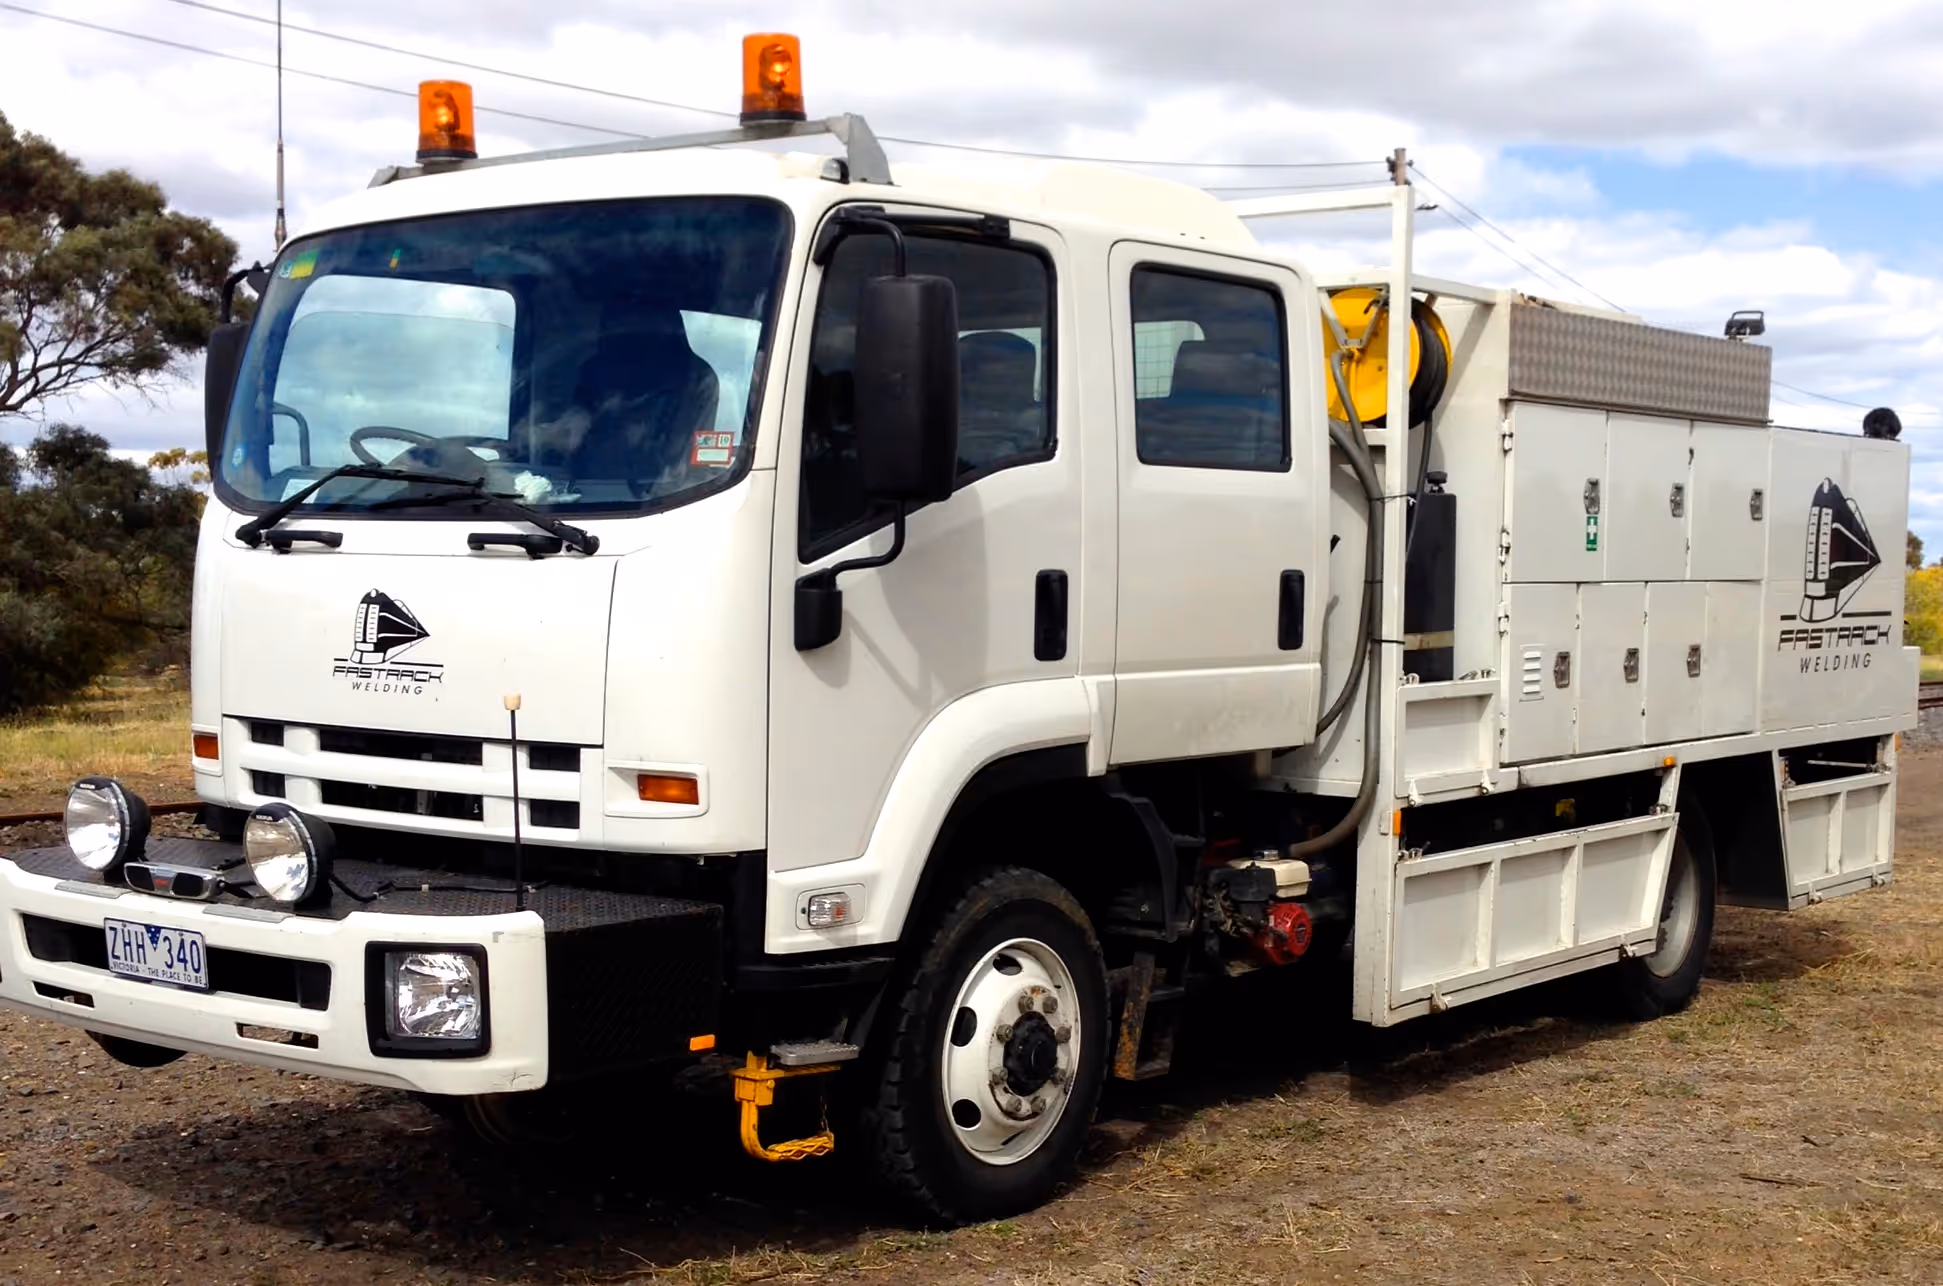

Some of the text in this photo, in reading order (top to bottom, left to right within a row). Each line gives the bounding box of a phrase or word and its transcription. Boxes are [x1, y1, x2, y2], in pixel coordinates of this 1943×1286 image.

[1778, 624, 1892, 651] FASTRACK
[332, 665, 444, 683] FASTRACK
[1800, 653, 1872, 674] WELDING
[352, 682, 423, 695] WELDING
[108, 926, 201, 974] ZHH 340
[113, 961, 140, 973] VICTORIA
[148, 967, 159, 977] THE
[162, 970, 181, 980] PLACE
[183, 973, 192, 983] TO
[195, 975, 202, 985] BE
